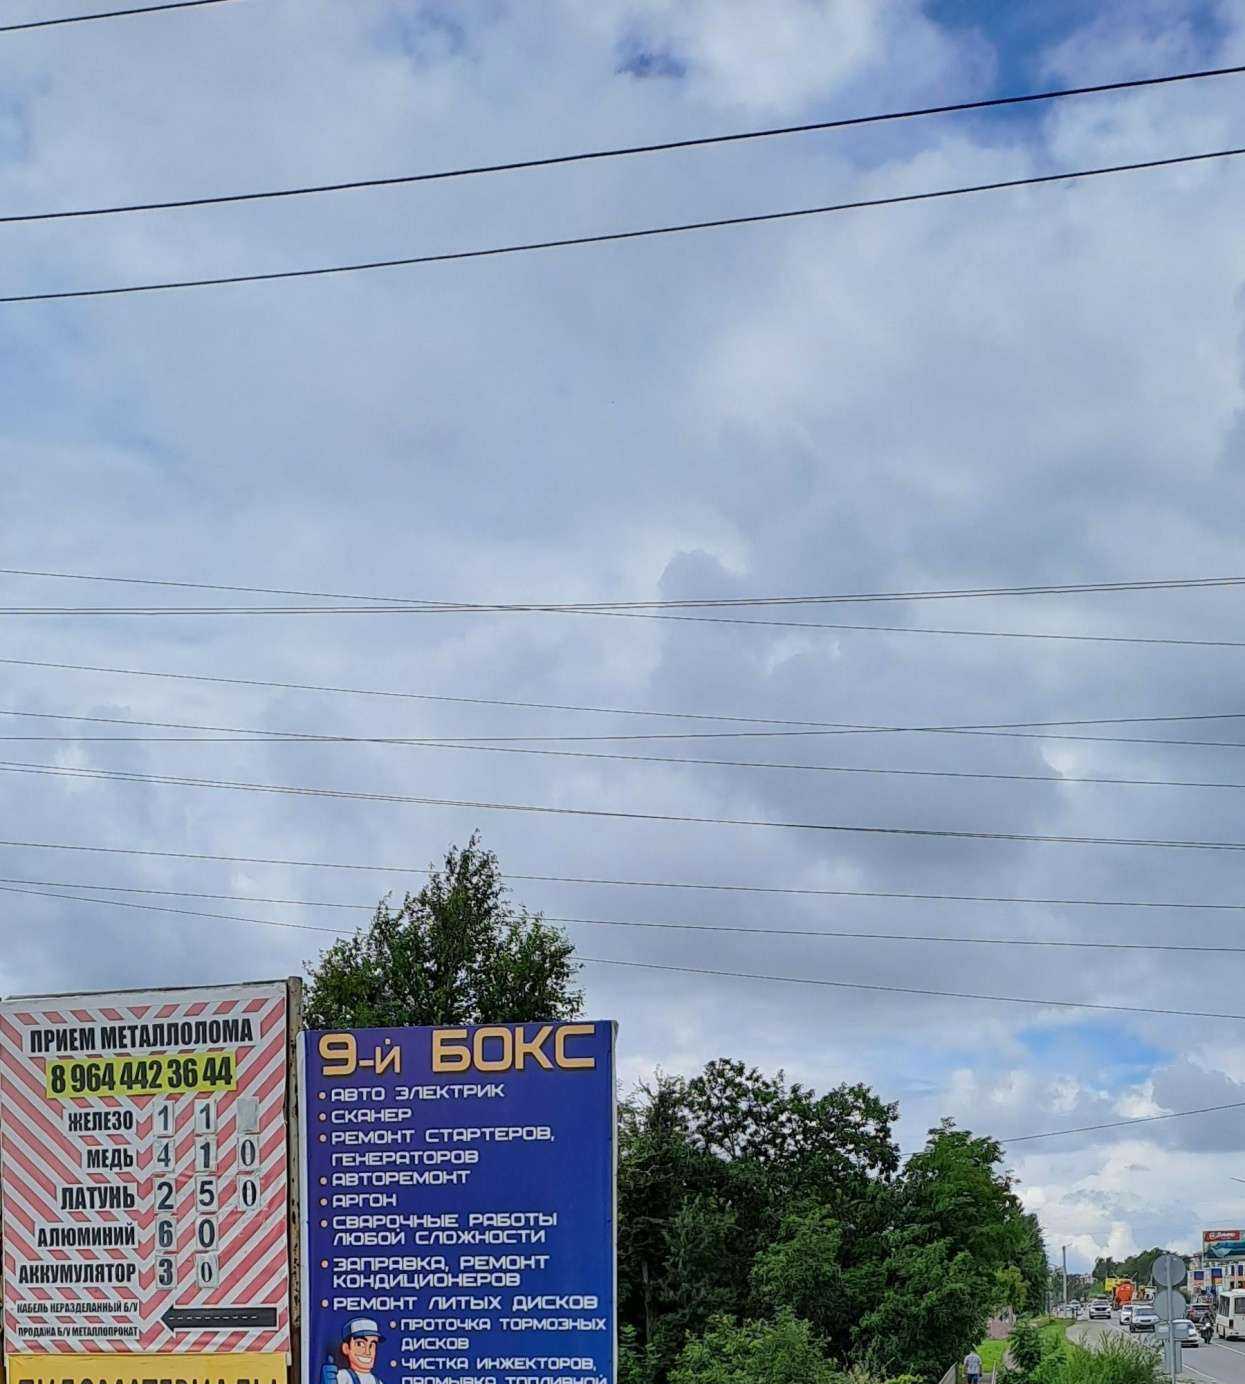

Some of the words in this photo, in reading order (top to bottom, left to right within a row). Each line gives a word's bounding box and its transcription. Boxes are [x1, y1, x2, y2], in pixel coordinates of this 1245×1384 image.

[30, 1027, 96, 1053] ПРИЕМ
[101, 1018, 254, 1050] МЕТАЛЛОЛОМА
[432, 1024, 596, 1073] БОКС
[51, 1064, 66, 1093] 8
[71, 1061, 116, 1092] 964
[120, 1059, 163, 1090] 442
[167, 1057, 198, 1088] 36
[203, 1056, 233, 1086] 44
[331, 1087, 386, 1102] АВТО
[395, 1084, 505, 1100] ЭЛЕКТРИК
[68, 1110, 134, 1133] ЖЕЛЕЗО
[331, 1108, 412, 1124] СКАНЕР
[331, 1130, 415, 1145] РЕМОНТ
[425, 1127, 555, 1143] СТАРТЕРОВ,
[86, 1149, 134, 1171] МЕДЬ
[331, 1150, 479, 1167] ГЕНЕРАТОРОВ
[331, 1170, 471, 1186] АВТОРЕМОНТ
[61, 1185, 136, 1210] ЛАТУНЬ
[332, 1193, 397, 1208] АРГОН
[332, 1214, 458, 1229] СВАРОЧНЫЕ
[469, 1212, 557, 1227] РАБОТЫ
[37, 1222, 136, 1248] АЛЮМИНИЙ
[333, 1228, 405, 1246] ЛЮБОЙ
[415, 1230, 545, 1245] СЛОЖНОСТИ
[333, 1257, 449, 1272] ЗАПРАВКА,
[460, 1255, 550, 1270] РЕМОНТ
[19, 1262, 137, 1284] АККУМУЛЯТОР
[333, 1272, 520, 1290] КОНДИЦИОНЕРОВ
[17, 1302, 49, 1314] КАБЕЛЬ
[50, 1300, 121, 1314] НЕРАЗДЕЛАННЫЙ
[123, 1302, 138, 1313] Б/У
[333, 1296, 417, 1311] РЕМОНТ
[428, 1296, 501, 1310] ЛИТЫХ
[512, 1295, 598, 1311] ДИСКОВ
[18, 1326, 56, 1338] ПРОДАЖА
[57, 1327, 71, 1337] Б/У
[72, 1326, 138, 1337] МЕТАЛЛОПРОКАТ
[401, 1318, 491, 1331] ПРОТОЧКА
[500, 1317, 606, 1331] ТОРМОЗНЫХ
[401, 1337, 470, 1351] ДИСКОВ
[402, 1357, 468, 1370] ЧИСТКА
[477, 1357, 596, 1371] ИНЖЕКТОРОВ,
